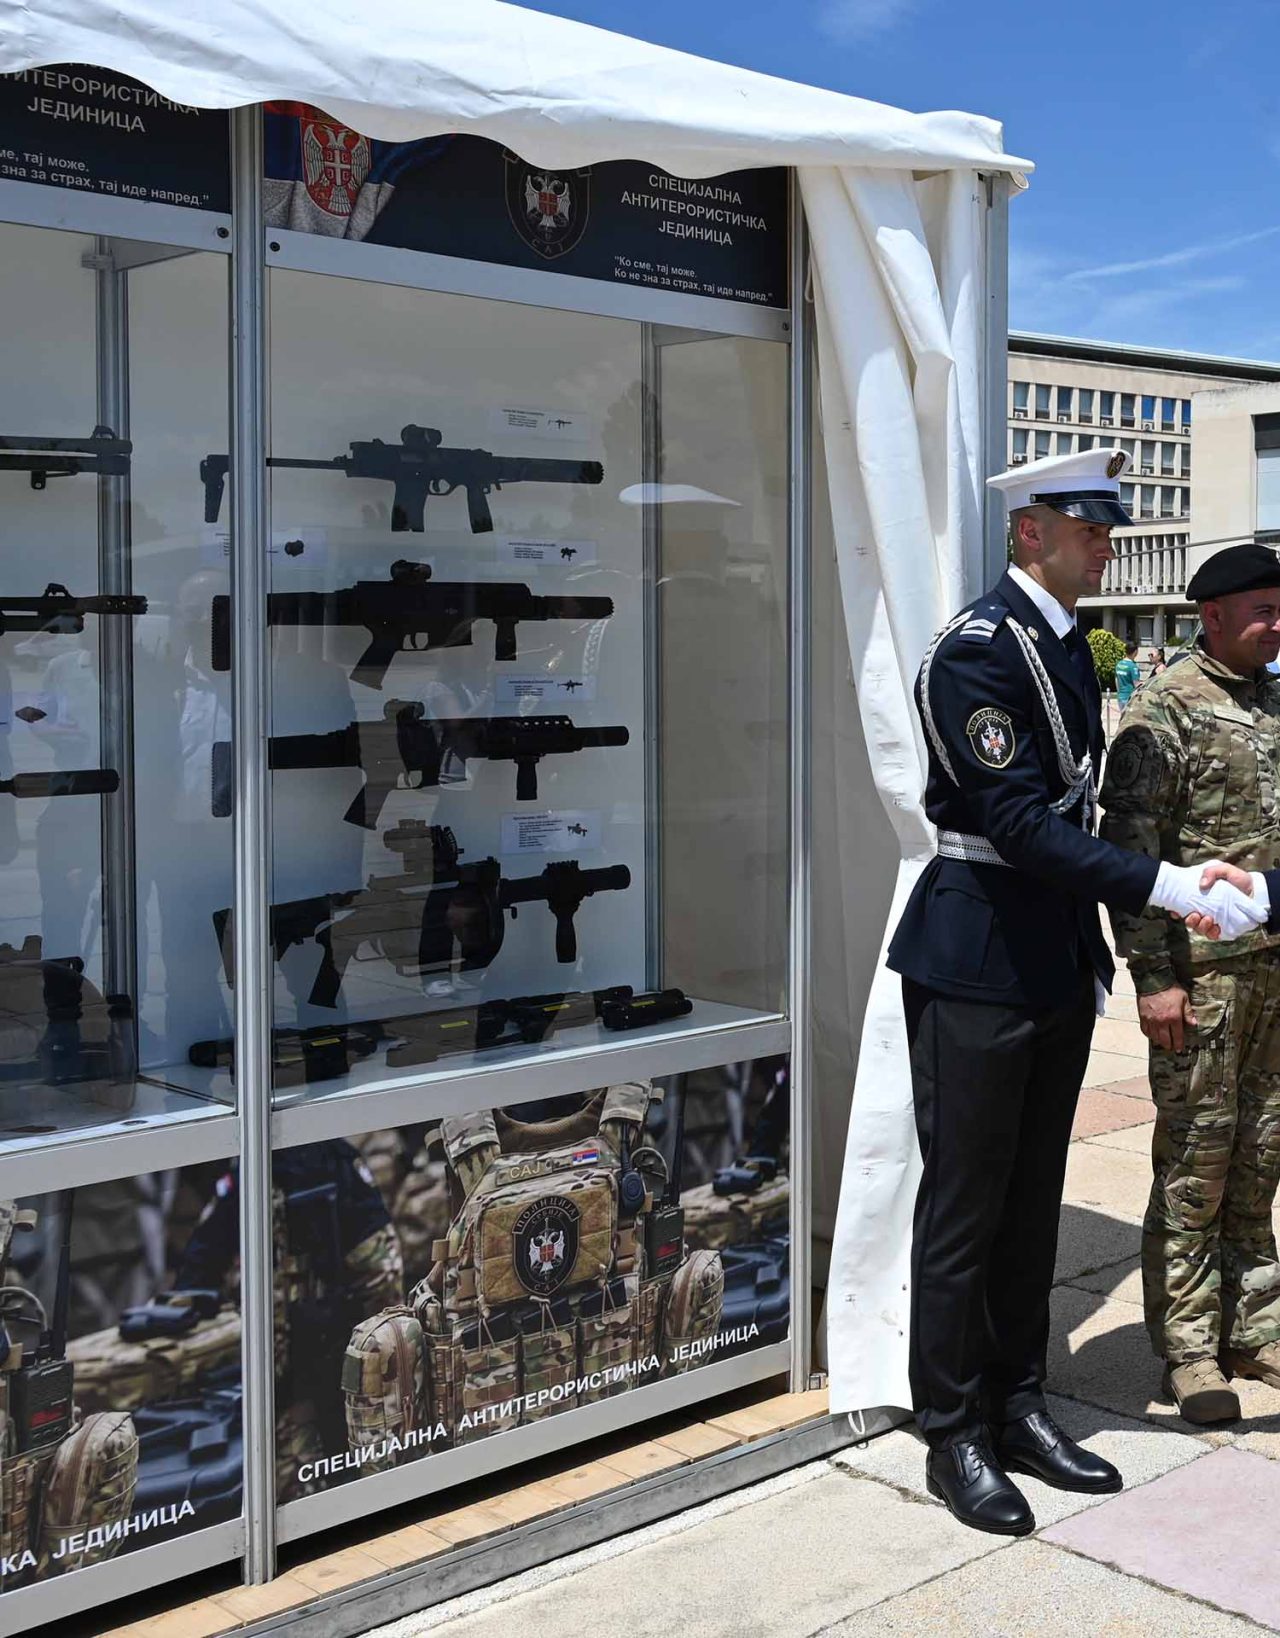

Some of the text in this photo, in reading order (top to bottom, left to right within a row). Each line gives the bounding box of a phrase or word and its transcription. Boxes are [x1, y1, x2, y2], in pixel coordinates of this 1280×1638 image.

[27, 97, 146, 132] ЈЕДИНИЦА
[23, 153, 43, 167] тај
[48, 156, 89, 172] може.
[1, 165, 26, 177] зна
[31, 169, 46, 180] за
[51, 172, 95, 188] страх,
[99, 180, 118, 194] тај
[122, 183, 147, 197] иде
[649, 174, 742, 205] СПЕЦИЈАЛНА
[621, 191, 767, 231] АНТИТЕРОРИСТИЧКА
[658, 221, 733, 246] ЈЕДИНИЦА
[614, 267, 627, 278] Ко
[629, 272, 640, 280] не
[642, 274, 658, 284] зна
[660, 277, 671, 285] за
[516, 1197, 577, 1228] ПОЛИЦИЈА
[298, 1322, 759, 1483] СПЕЦИЈАЛНА АНТИТЕРОРИСТИЧКА ЈЕДИНИЦА
[52, 1500, 196, 1560] ЈЕДИНИЦА
